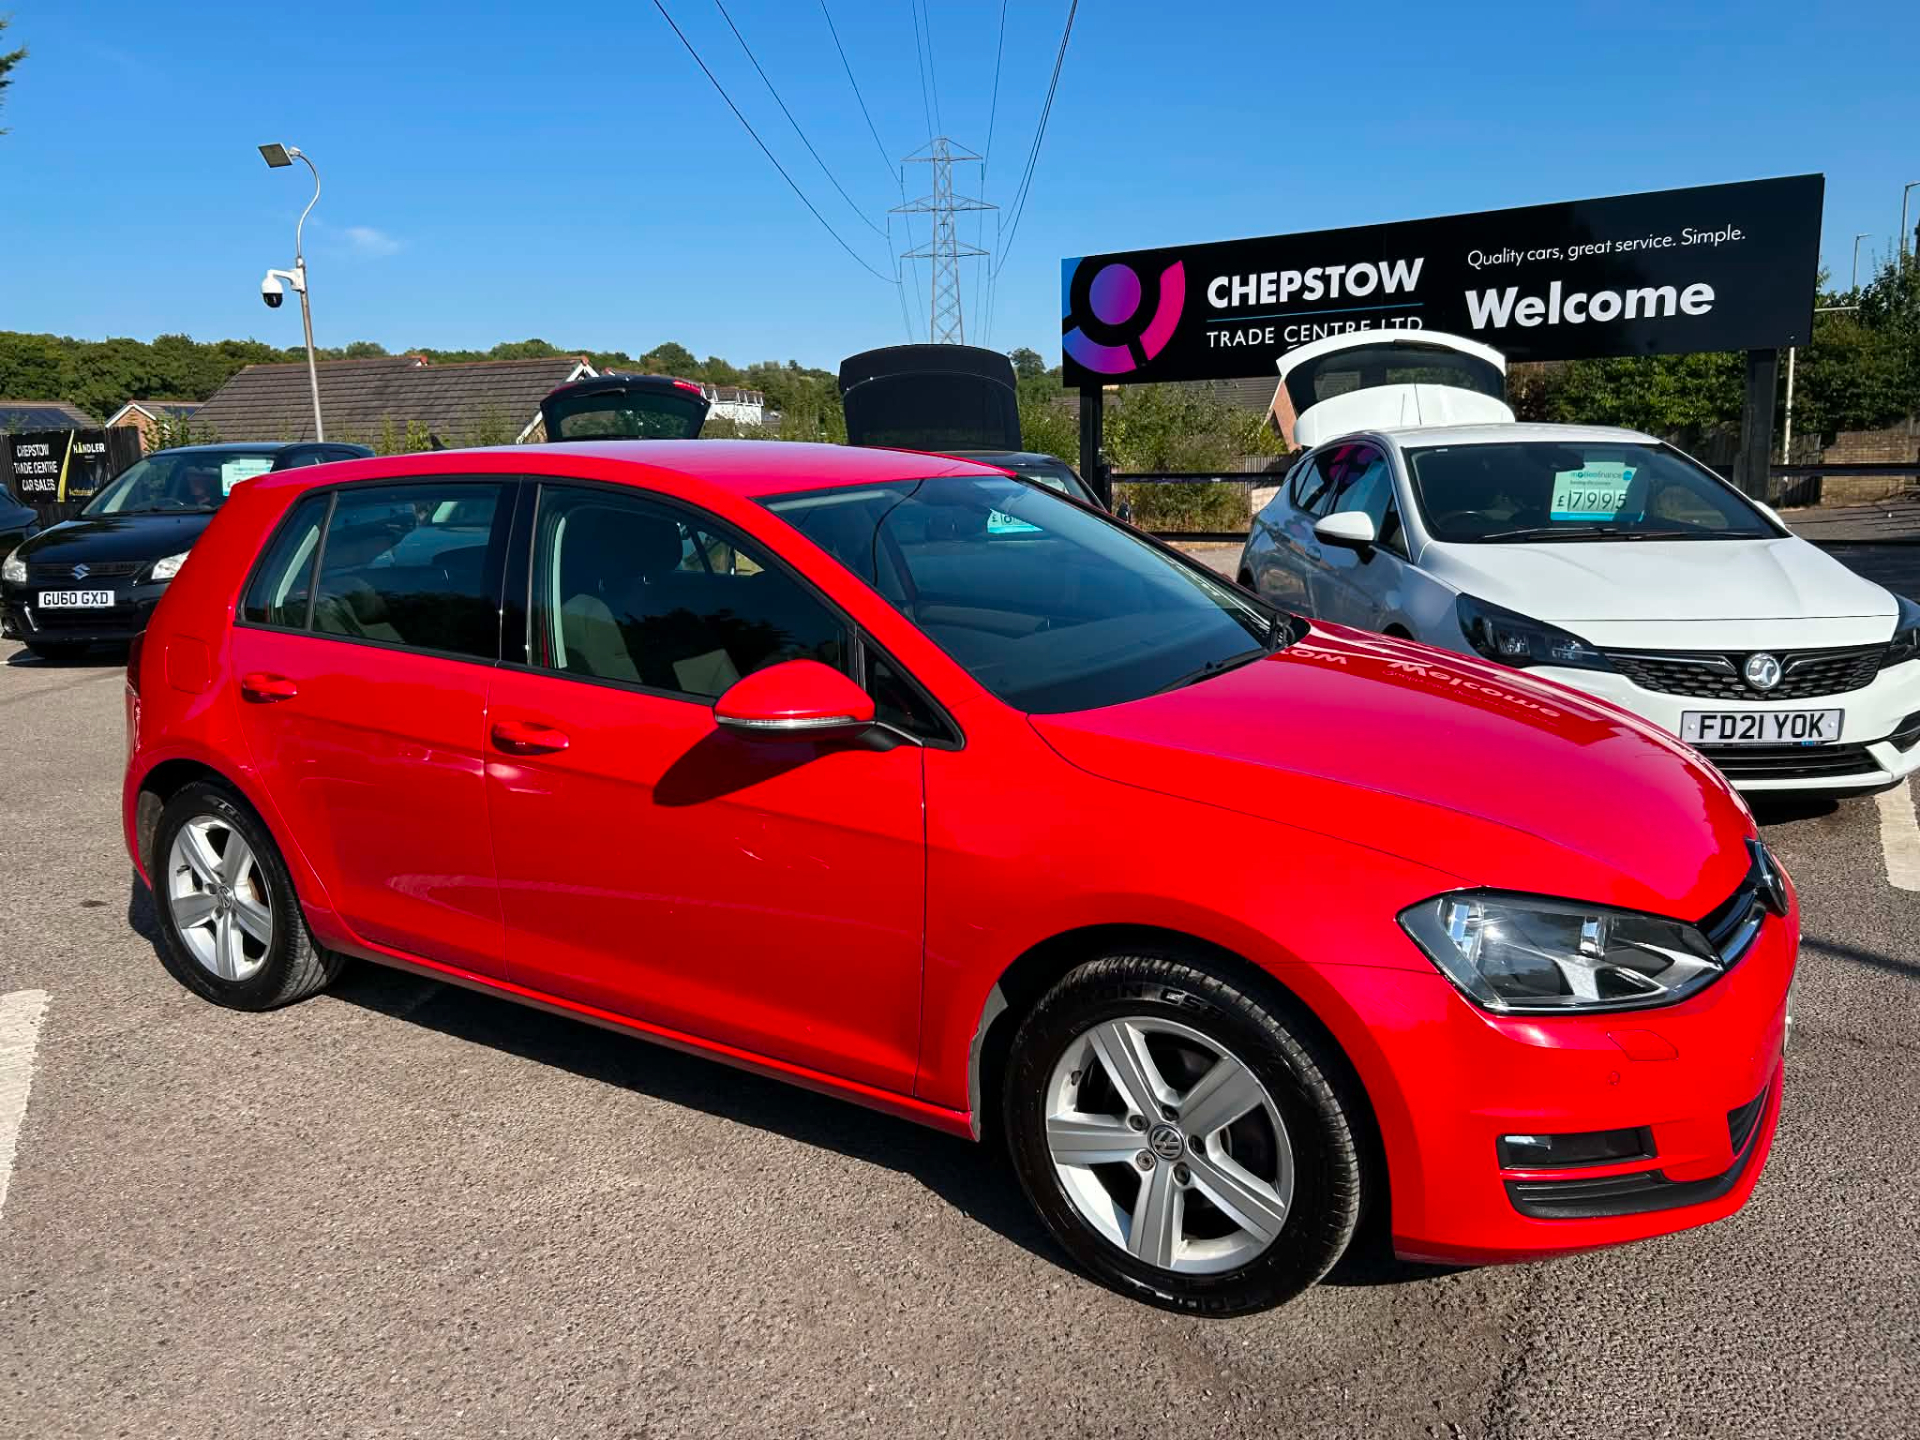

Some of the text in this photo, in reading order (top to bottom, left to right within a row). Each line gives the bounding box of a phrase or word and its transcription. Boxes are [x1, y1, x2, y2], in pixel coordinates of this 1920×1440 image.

[1467, 224, 1746, 270] Quality cars, great service. Simple.
[1207, 257, 1424, 309] CHEPSTOW
[1465, 280, 1715, 330] Welcome
[1206, 327, 1275, 348] TRADE
[1283, 320, 1371, 343] CENTRE
[16, 443, 50, 457] CHEPSTOW
[13, 460, 58, 475] TRADE CENTRE
[22, 478, 56, 491] CAR SALES
[43, 592, 108, 605] GU60 GXD
[1698, 713, 1825, 739] FD21 YOK
